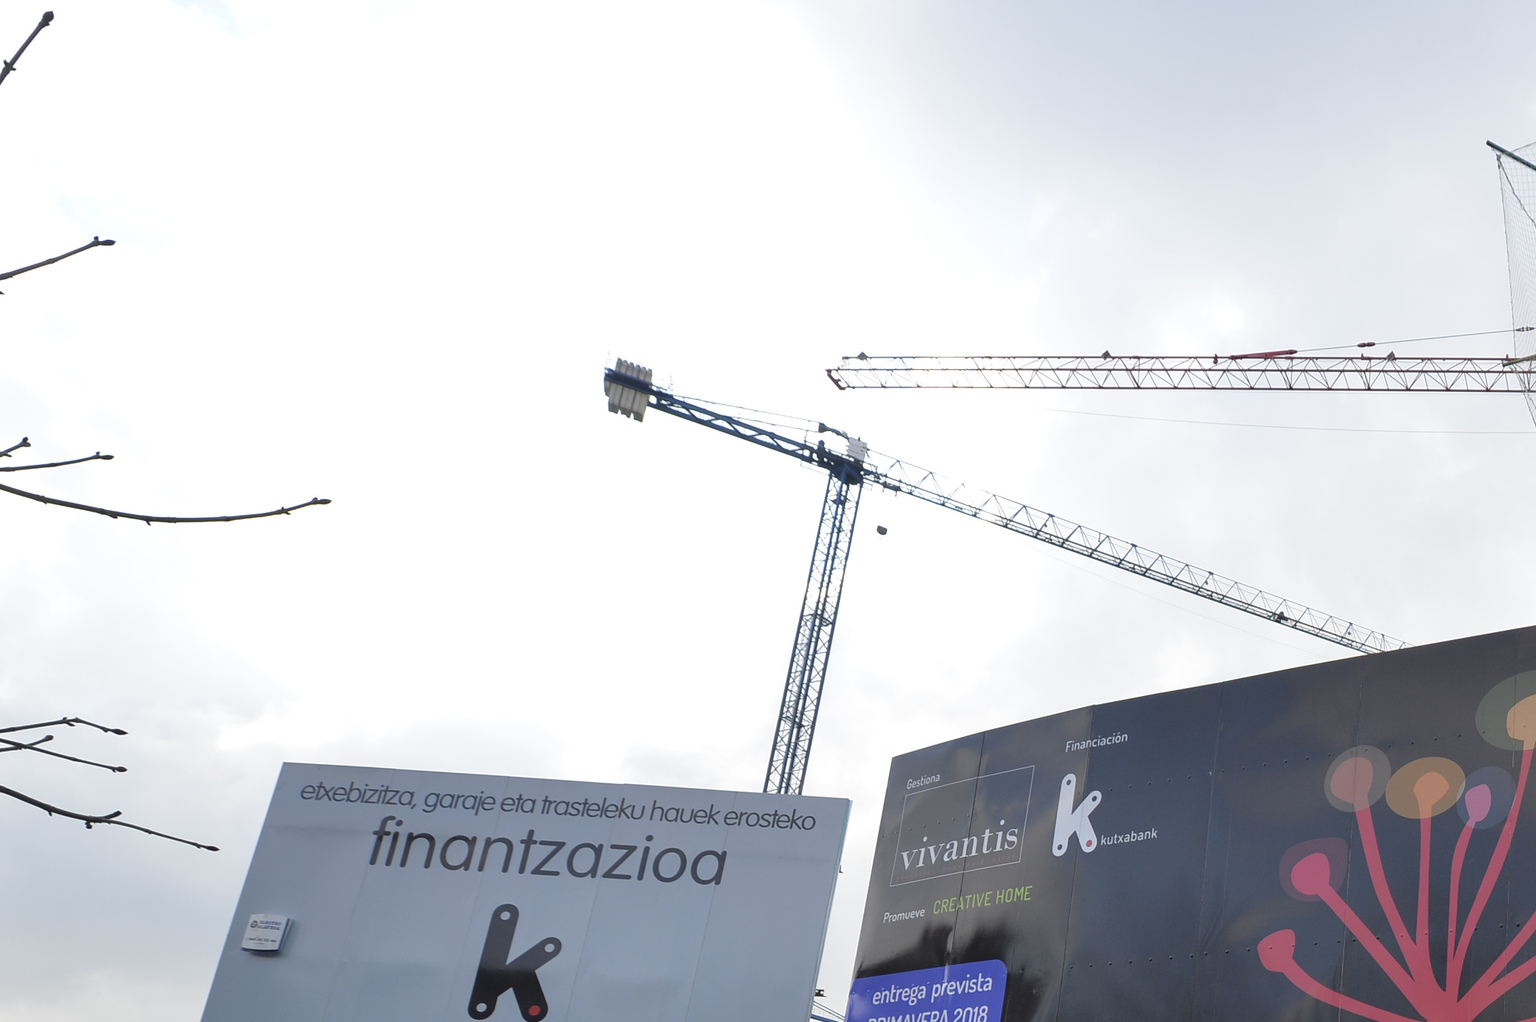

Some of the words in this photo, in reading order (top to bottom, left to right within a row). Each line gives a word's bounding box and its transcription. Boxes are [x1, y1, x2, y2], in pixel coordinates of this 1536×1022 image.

[1065, 732, 1128, 753] Financiación
[906, 772, 940, 790] Gestiona
[300, 781, 417, 810] etxebizitza,
[422, 791, 496, 816] garaje
[500, 793, 537, 814] eta
[541, 796, 646, 820] trasteleku
[650, 800, 721, 825] hauek
[723, 809, 816, 831] erosteko
[369, 815, 728, 886] finantzazioa
[901, 819, 1019, 872] vivantis
[1100, 828, 1158, 846] kutxabank
[883, 906, 926, 925] Promueve
[933, 891, 993, 915] CREATIVE
[996, 885, 1033, 905] HOME
[872, 984, 927, 1006] entrega
[931, 973, 993, 1003] prevista
